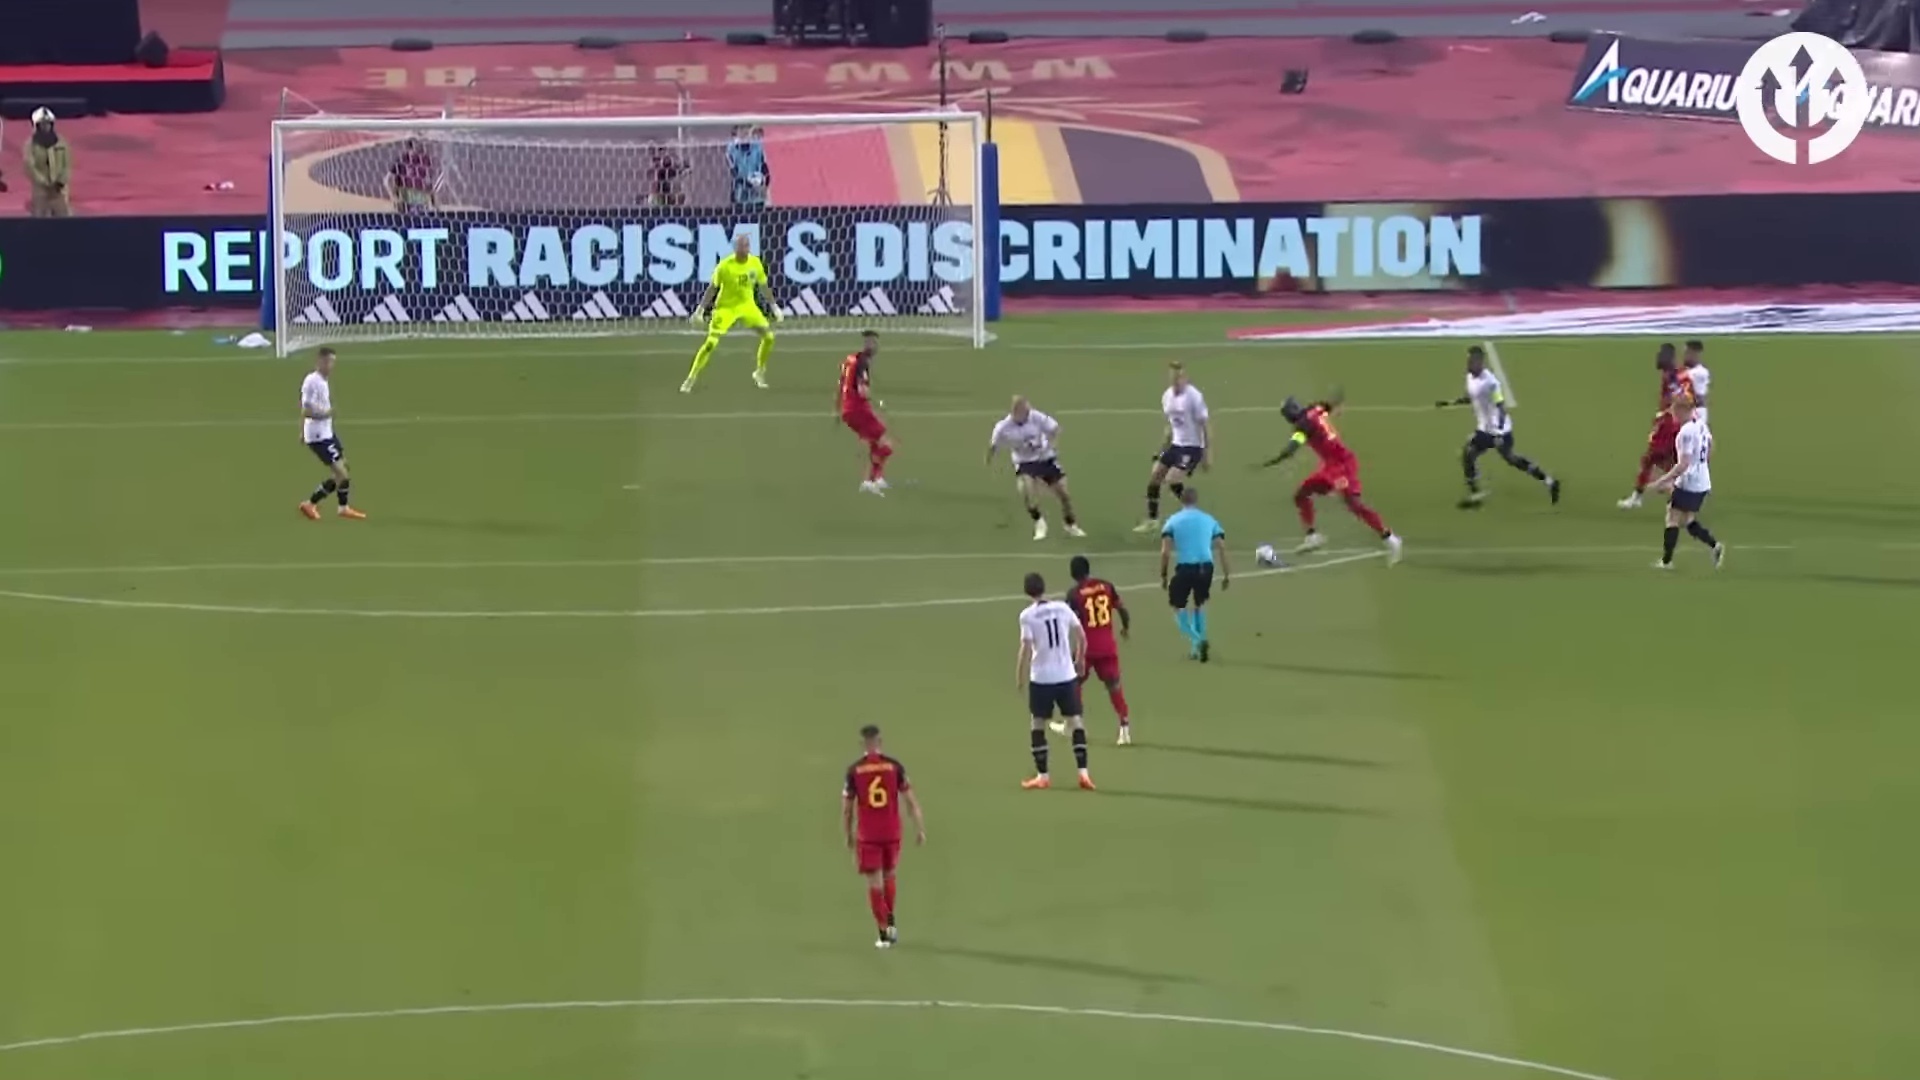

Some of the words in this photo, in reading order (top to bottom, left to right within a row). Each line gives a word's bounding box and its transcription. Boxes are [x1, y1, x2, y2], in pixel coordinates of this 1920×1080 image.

[1572, 38, 1743, 111] AQUARIU
[163, 227, 449, 292] REPORT
[468, 223, 760, 288] RACISM
[783, 222, 834, 283] &
[855, 214, 1481, 284] DISCRIMINATION
[1085, 595, 1110, 628] 18
[1045, 618, 1060, 649] 11
[868, 775, 888, 808] 6
